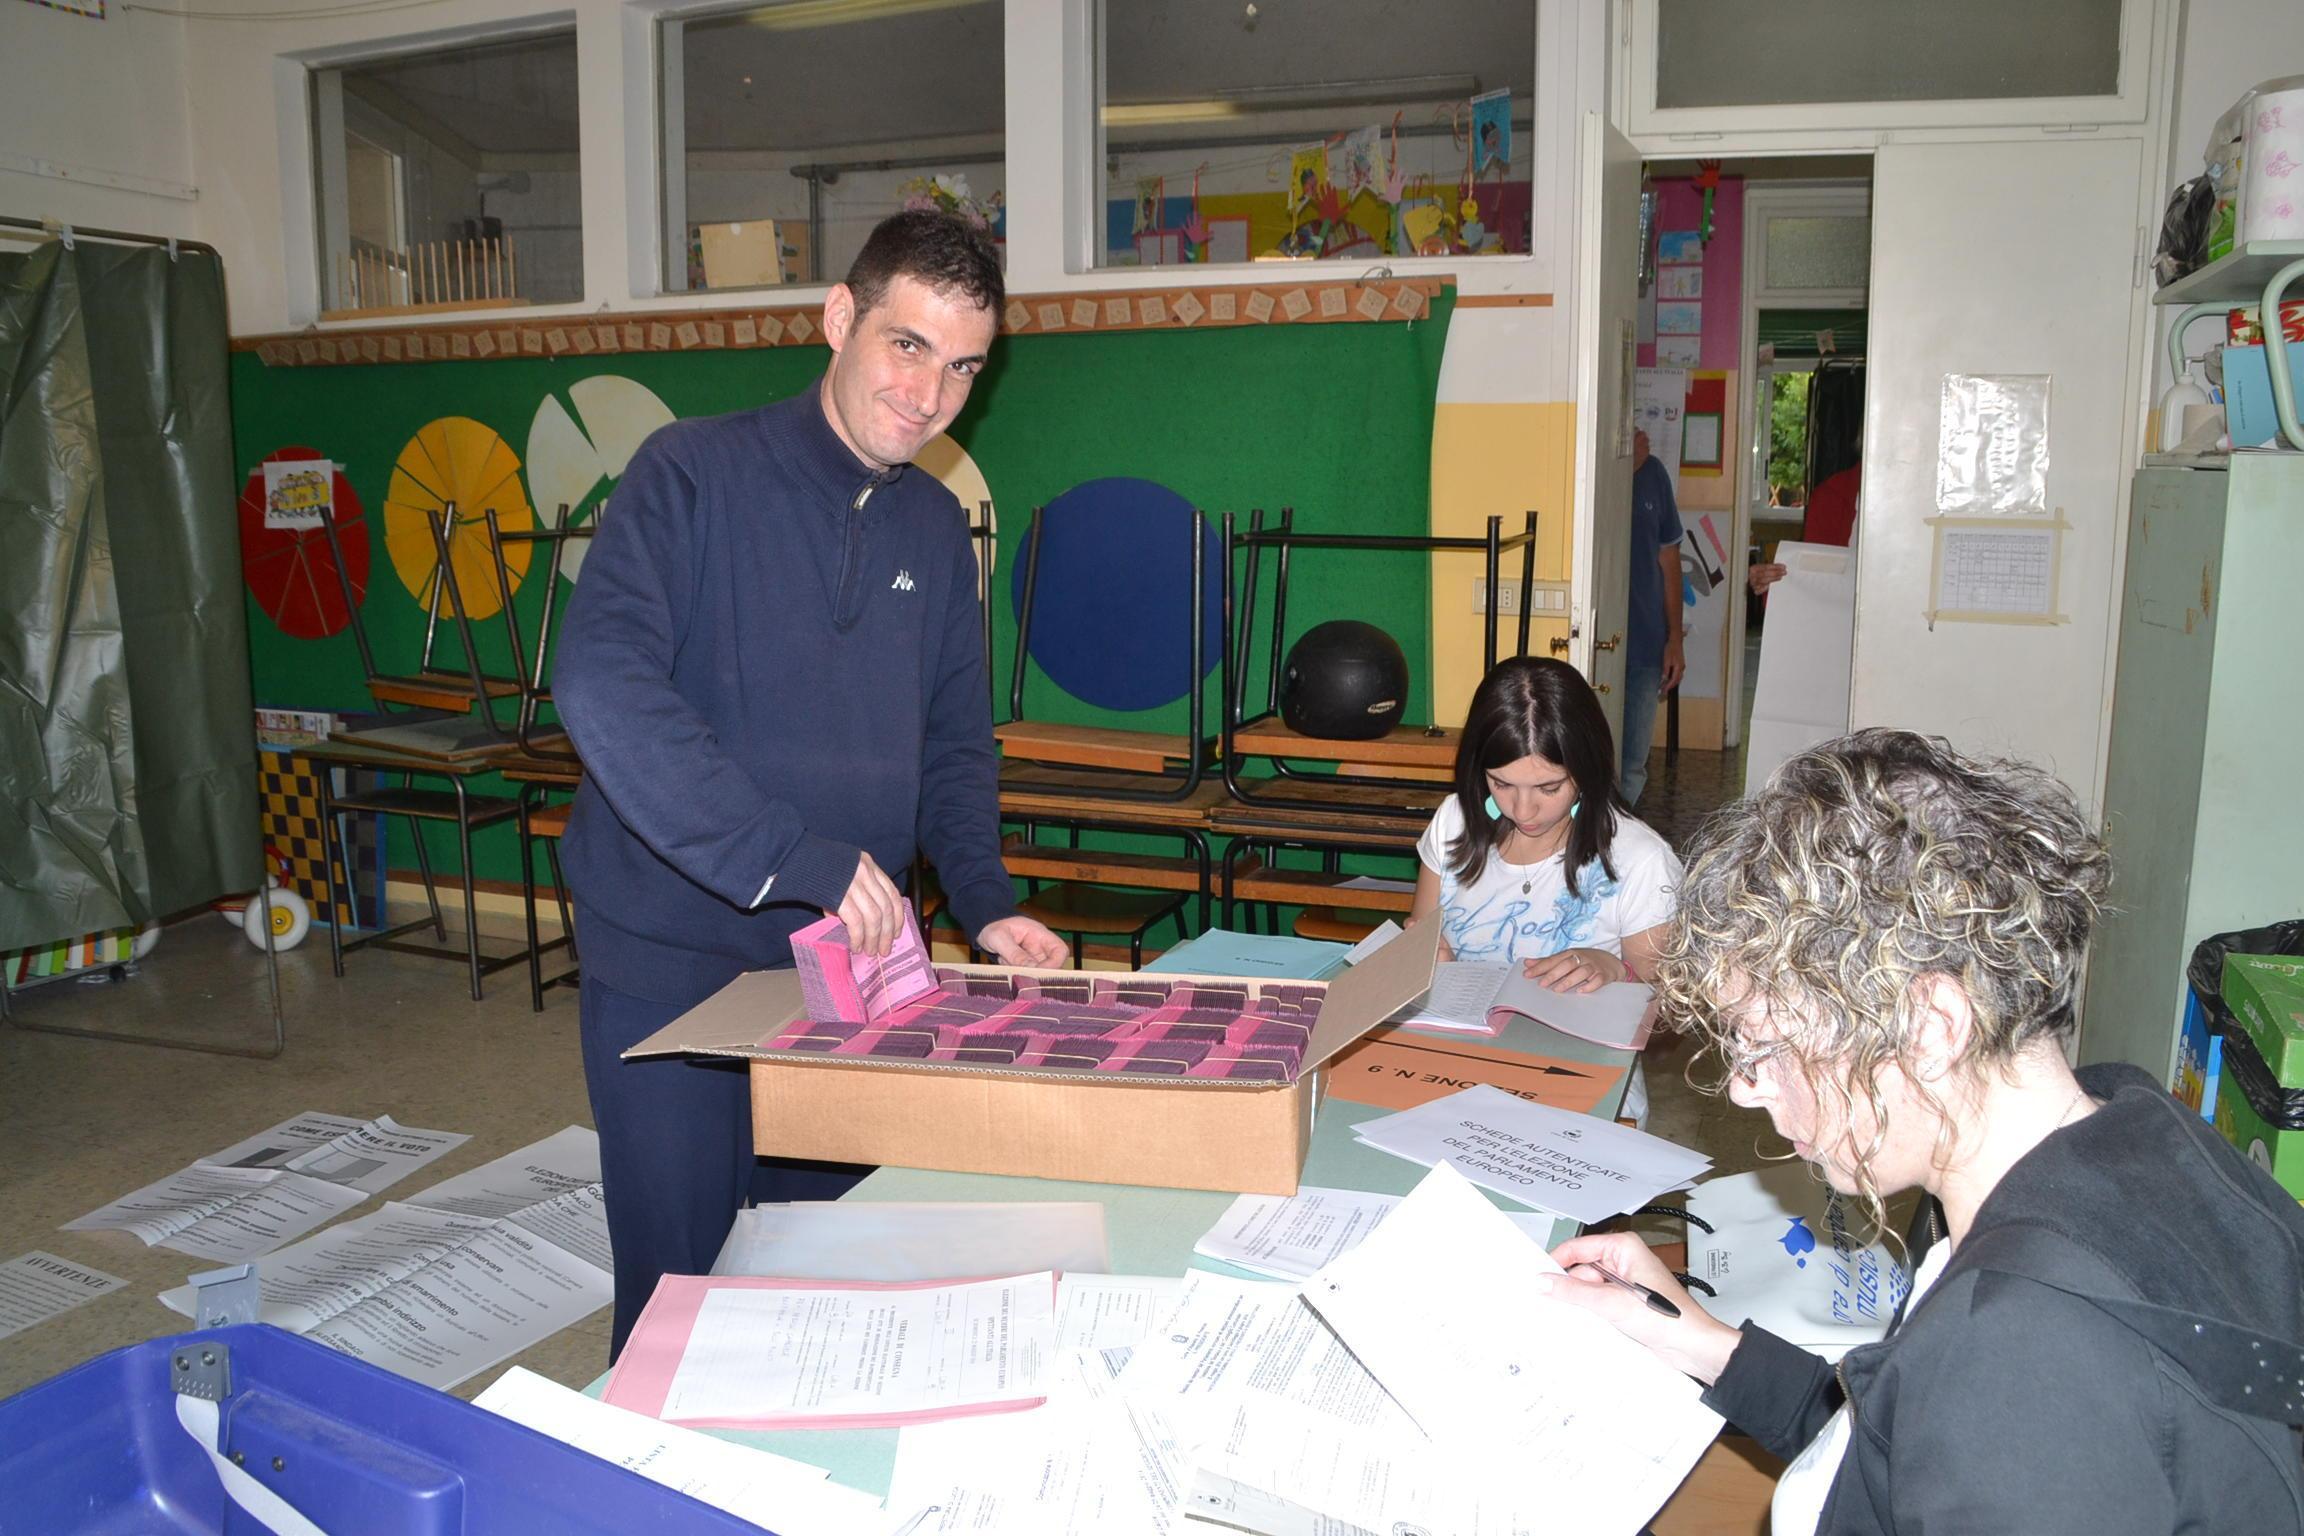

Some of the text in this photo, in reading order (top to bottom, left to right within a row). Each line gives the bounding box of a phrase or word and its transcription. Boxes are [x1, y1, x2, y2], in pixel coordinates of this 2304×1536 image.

[1493, 901, 1587, 962] Rock
[1367, 1064, 1539, 1100] SEONE N. 9
[289, 1124, 321, 1136] COME
[399, 1142, 433, 1153] VOTO
[1459, 1119, 1524, 1146] SCHEDE
[1524, 1143, 1631, 1182] AUTENTICATE
[1442, 1137, 1582, 1191] DEL PARLAMENTO
[1455, 1154, 1535, 1186] EUROPEO
[1467, 1134, 1590, 1181] PER L'ELEZIONE
[26, 1256, 112, 1289] AVVERTENZE
[461, 1245, 504, 1273] conservare
[1827, 1260, 1851, 1289] di
[409, 1282, 459, 1317] smarrimento
[392, 1306, 427, 1332] indirizzo
